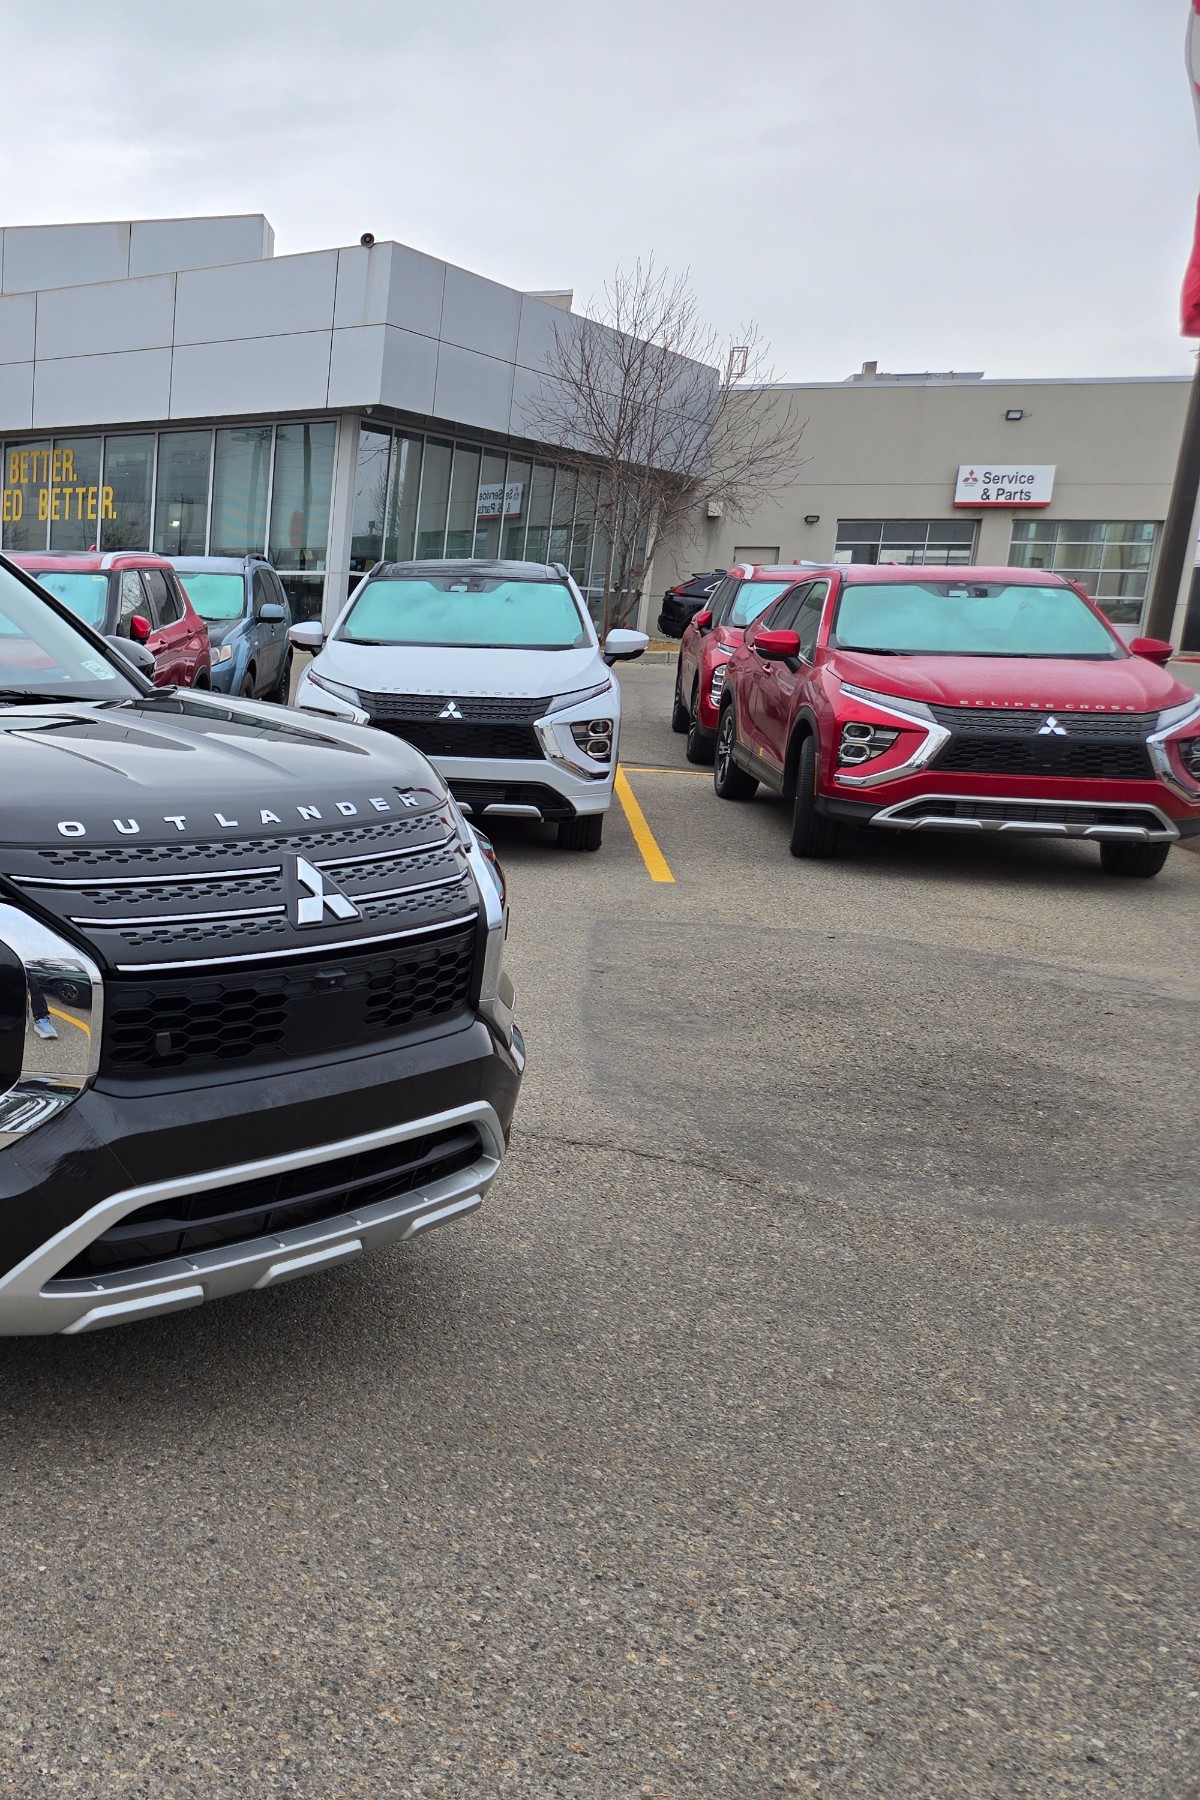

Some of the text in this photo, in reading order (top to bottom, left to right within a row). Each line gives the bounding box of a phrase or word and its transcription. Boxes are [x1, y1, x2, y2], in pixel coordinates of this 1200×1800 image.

[9, 449, 78, 484] BETTER.
[982, 471, 1035, 485] Service
[38, 486, 117, 521] BETTER.
[980, 487, 1032, 501] & Parts
[960, 700, 1054, 708] ECLIPSE
[57, 793, 420, 837] OUTLANDER
